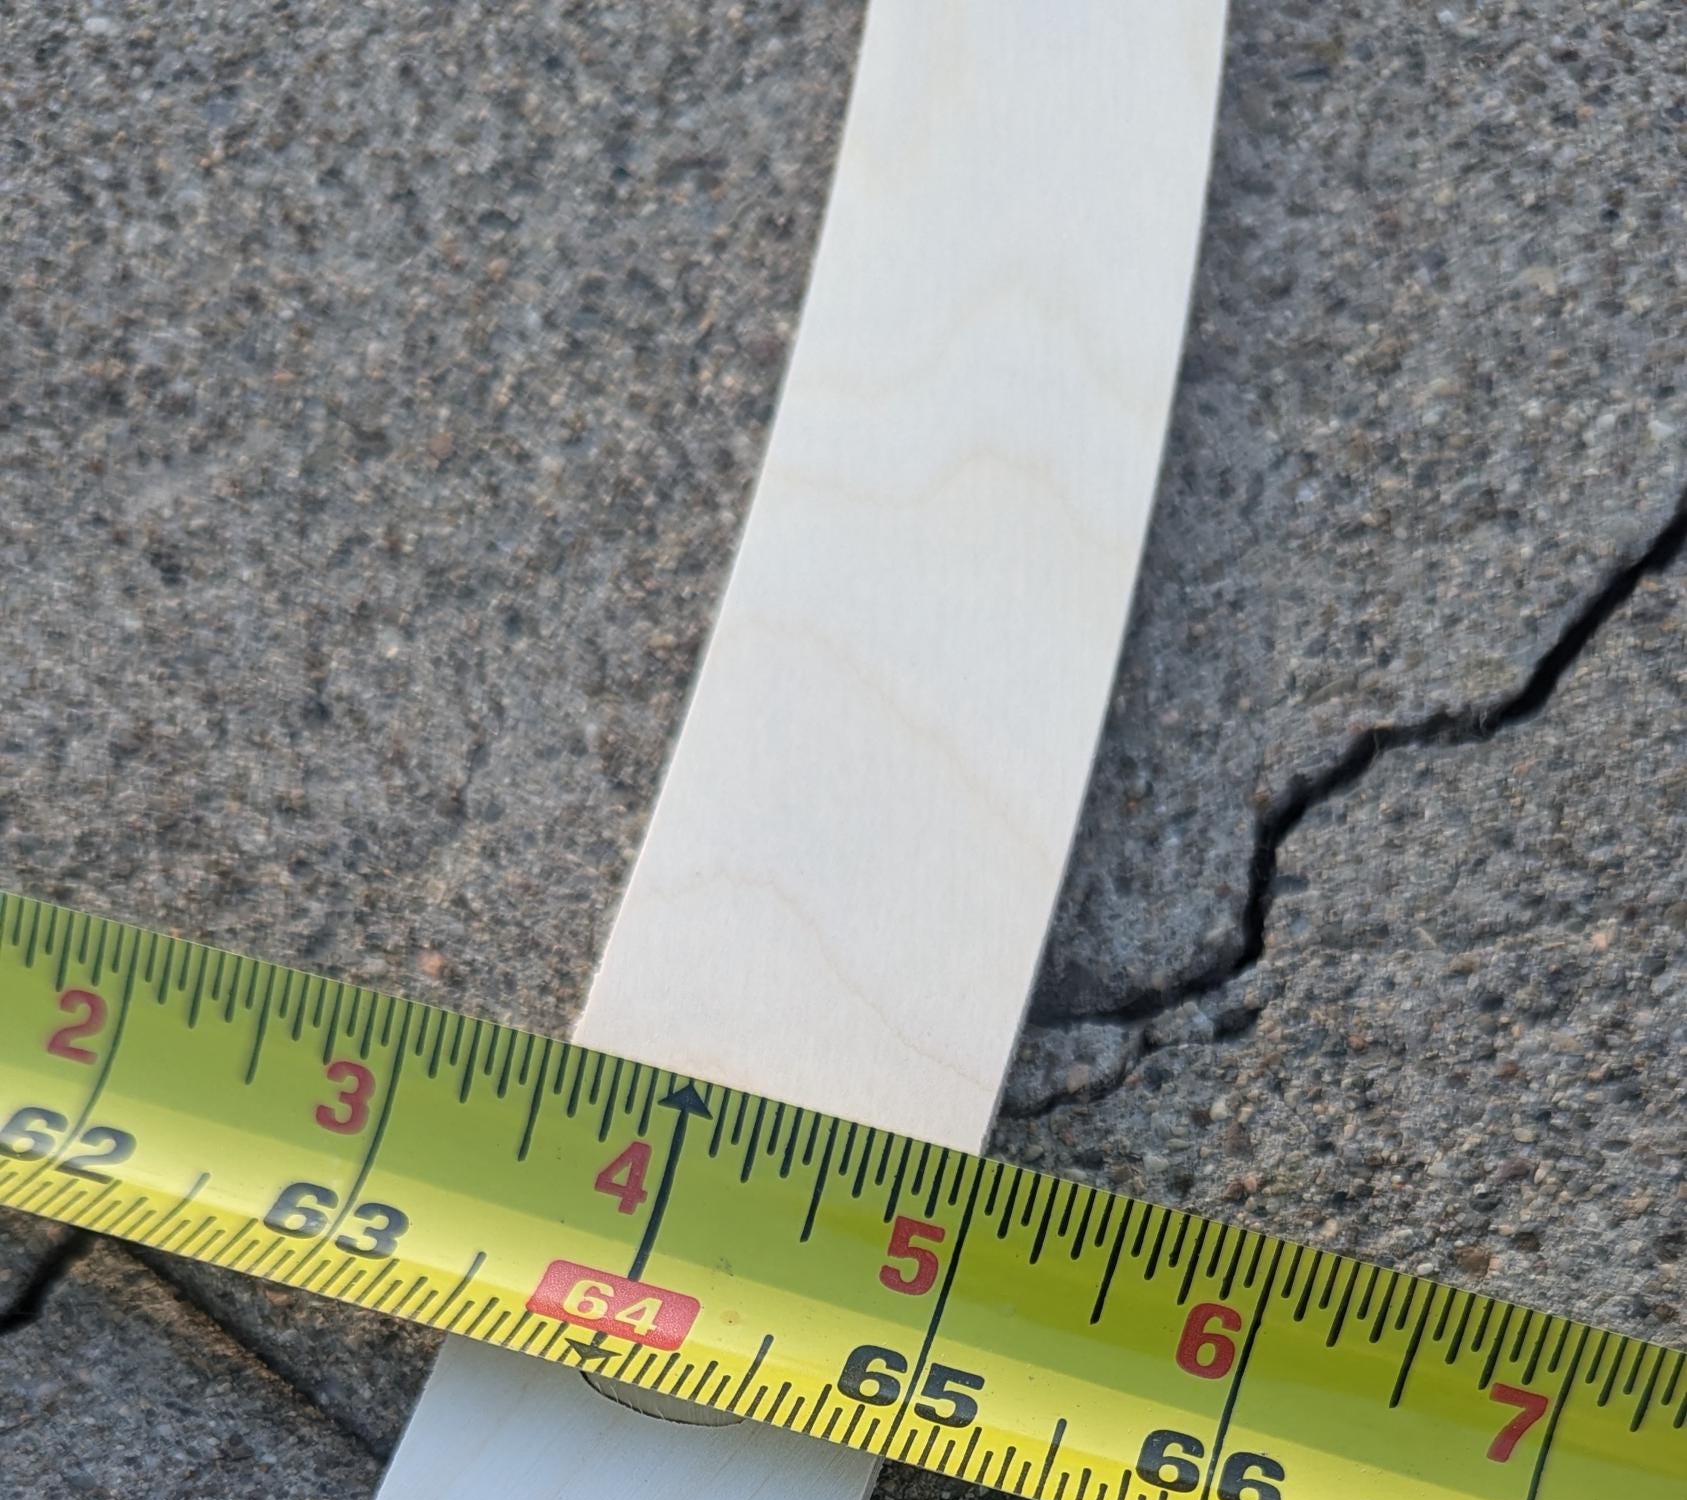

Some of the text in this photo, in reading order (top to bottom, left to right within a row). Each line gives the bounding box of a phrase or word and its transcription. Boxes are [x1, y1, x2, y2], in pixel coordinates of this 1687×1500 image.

[0, 1107, 137, 1183] 62
[264, 1183, 408, 1259] 63
[562, 1280, 663, 1336] 64
[837, 1345, 985, 1428] 65
[46, 989, 1548, 1462] 2 3 4 5 6 7
